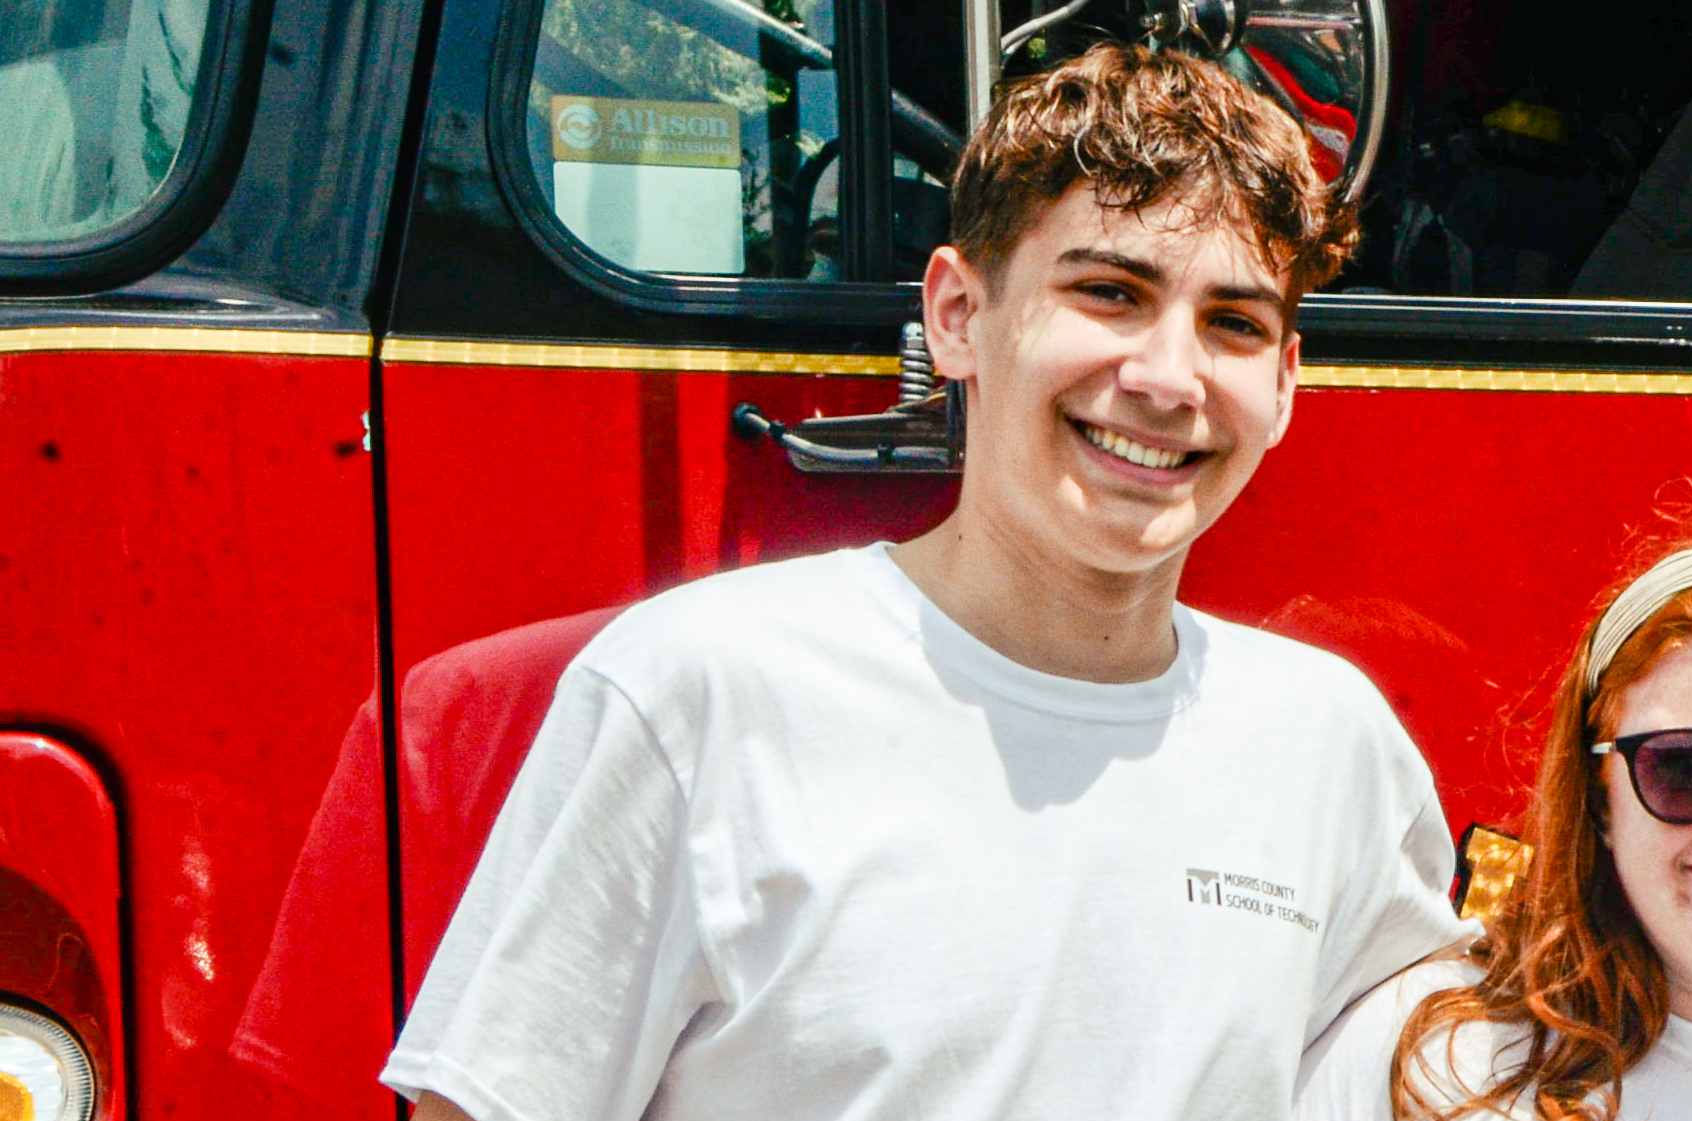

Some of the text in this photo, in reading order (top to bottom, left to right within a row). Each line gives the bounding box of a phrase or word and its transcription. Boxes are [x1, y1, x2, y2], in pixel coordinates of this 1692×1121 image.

[610, 107, 733, 138] Allison
[1224, 873, 1296, 901] MORRIS COUNTY
[1226, 894, 1262, 915] SCHOOL
[1264, 902, 1275, 917] OF
